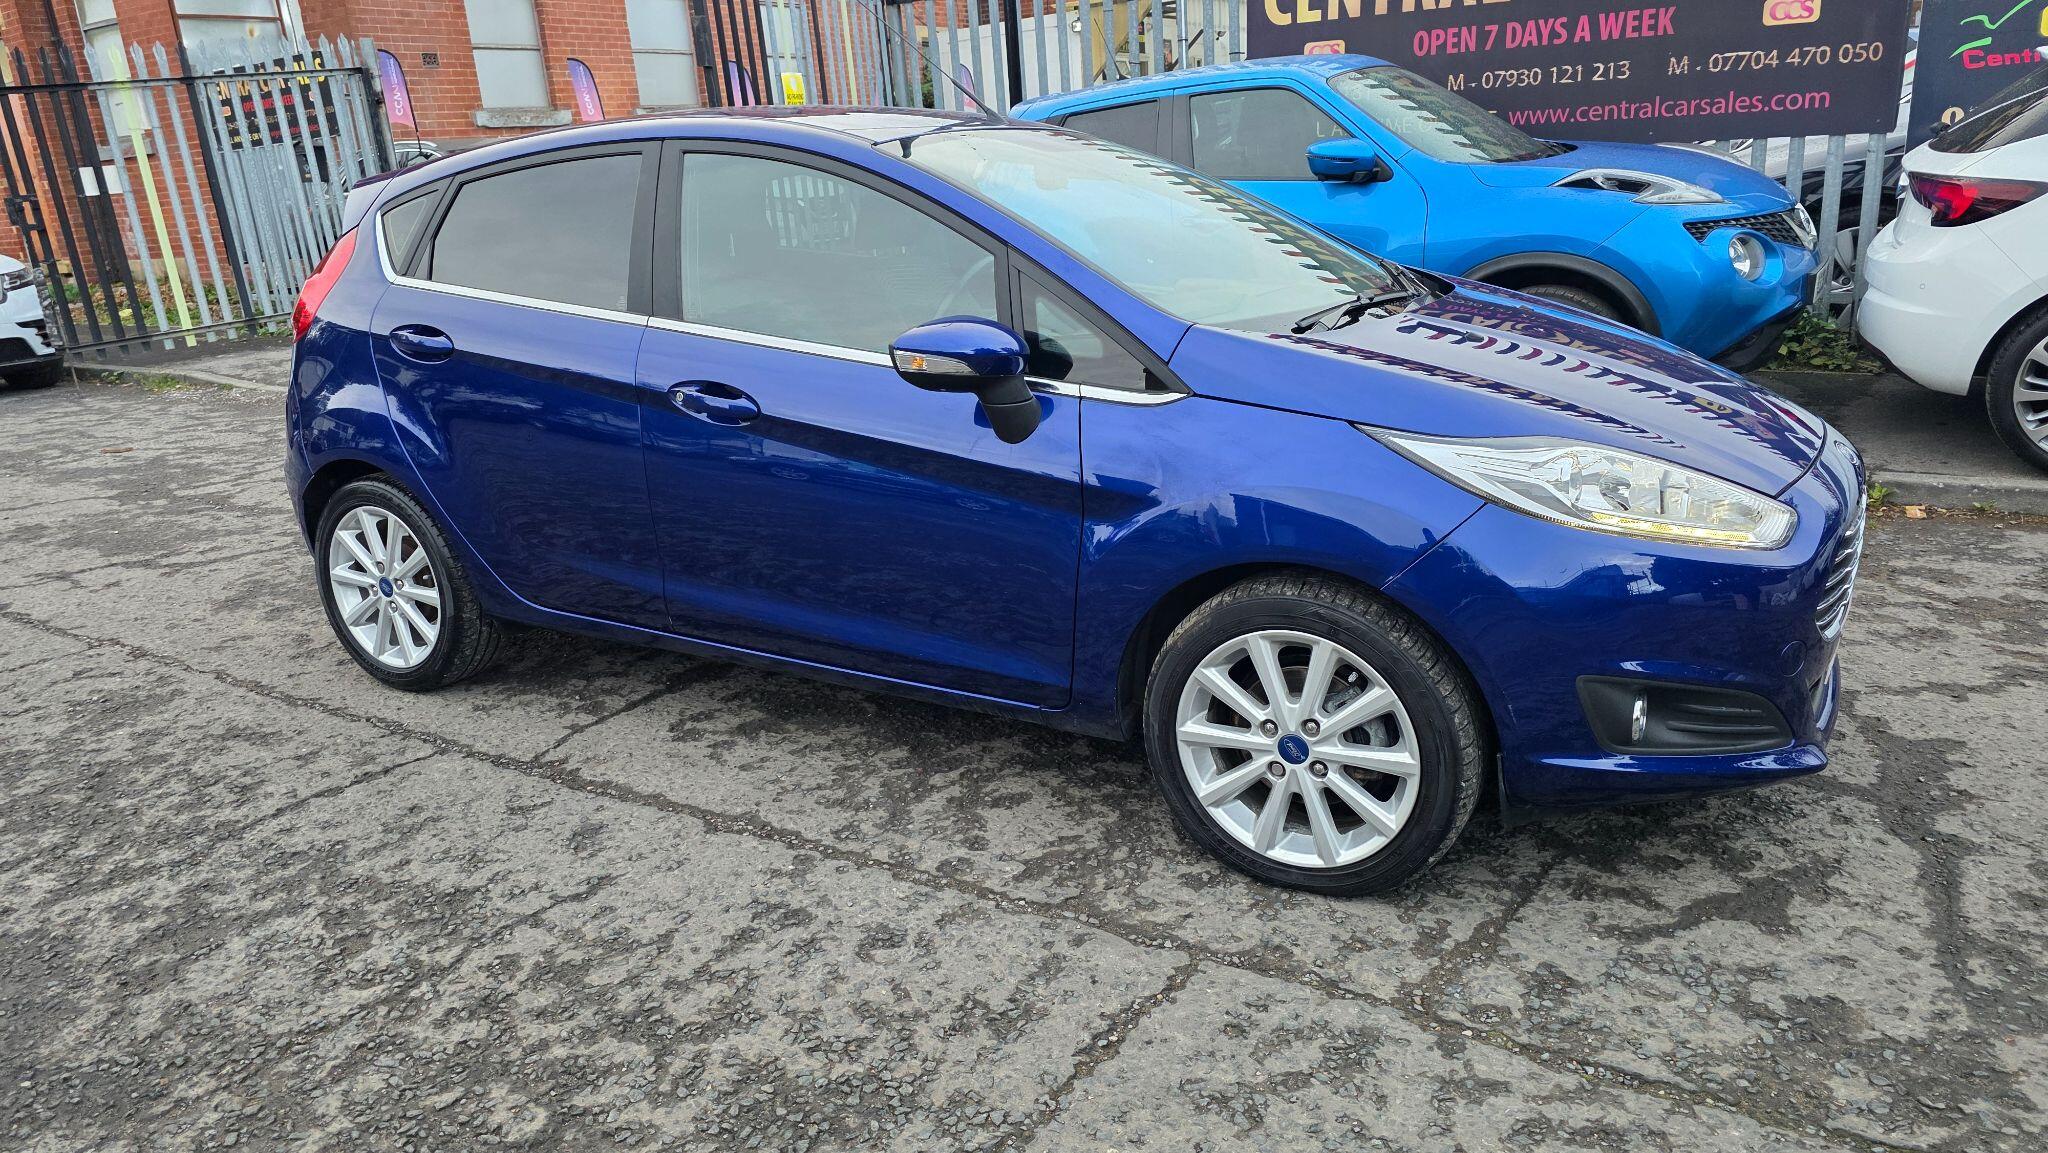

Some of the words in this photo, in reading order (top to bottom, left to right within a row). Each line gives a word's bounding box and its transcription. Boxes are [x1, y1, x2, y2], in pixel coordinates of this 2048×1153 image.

[1770, 0, 1814, 21] CCS
[1413, 26, 1477, 57] OPEN
[1484, 25, 1499, 51] 7
[1505, 17, 1568, 49] DAYS
[1573, 15, 1591, 43] A
[1598, 6, 1677, 41] WEEK
[1668, 55, 1690, 75] M
[1708, 50, 1779, 73] 07704
[1785, 45, 1831, 66] 470
[1838, 41, 1884, 64] 050
[1447, 73, 1464, 91] M
[1481, 67, 1542, 89] 07930
[1550, 64, 1583, 84] 121
[1592, 60, 1632, 81] 213
[1508, 91, 1831, 126] www.centralcarsales.com
